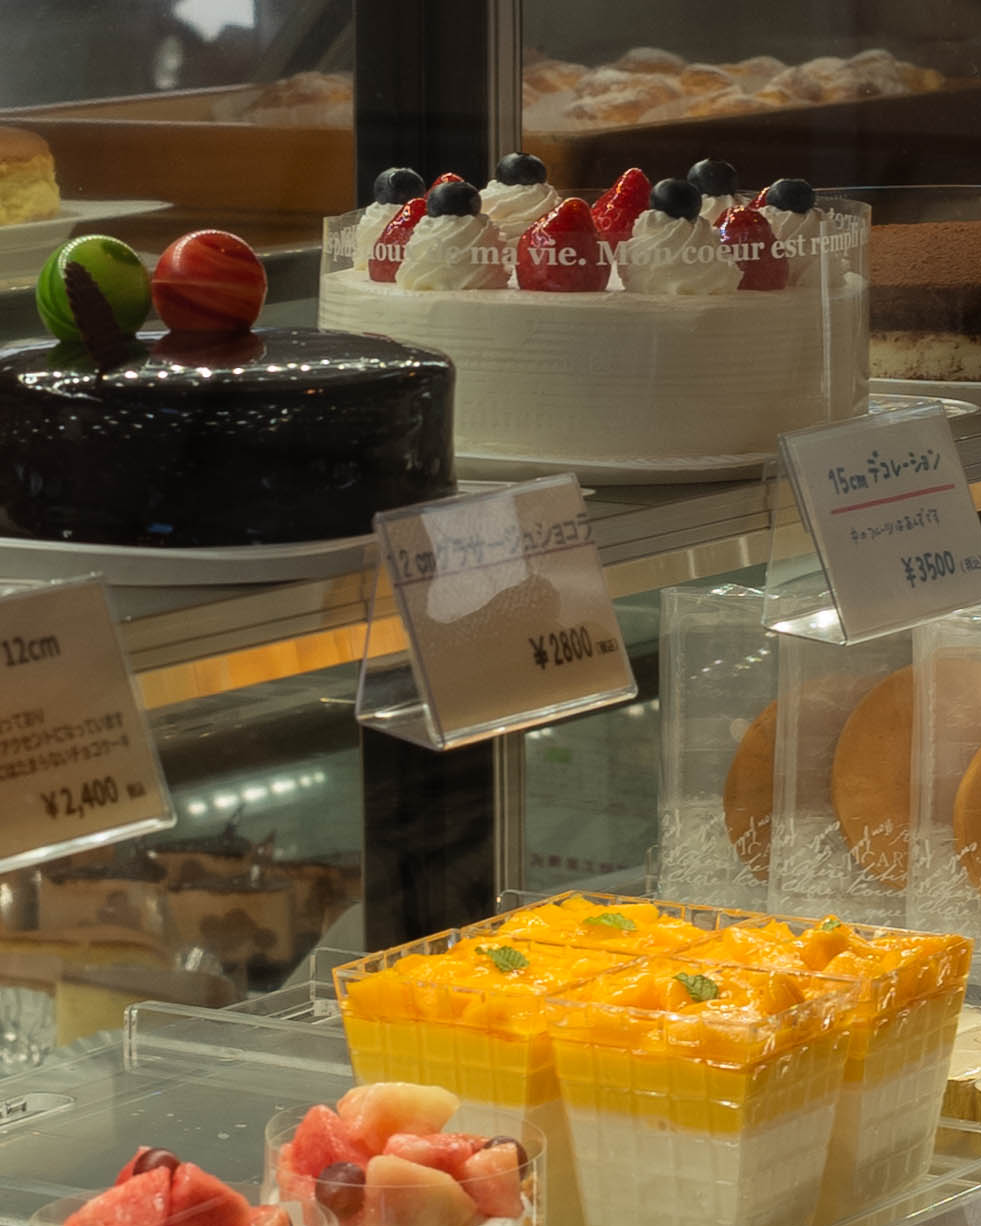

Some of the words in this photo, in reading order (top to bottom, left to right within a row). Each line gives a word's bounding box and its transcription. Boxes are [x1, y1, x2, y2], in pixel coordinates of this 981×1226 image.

[472, 246, 519, 266] ma
[527, 240, 587, 266] vie.
[596, 241, 674, 266] Mon
[771, 234, 806, 259] est
[901, 550, 956, 589] ¥3500
[528, 625, 593, 671] ¥2800
[40, 776, 120, 820] ¥2,400
